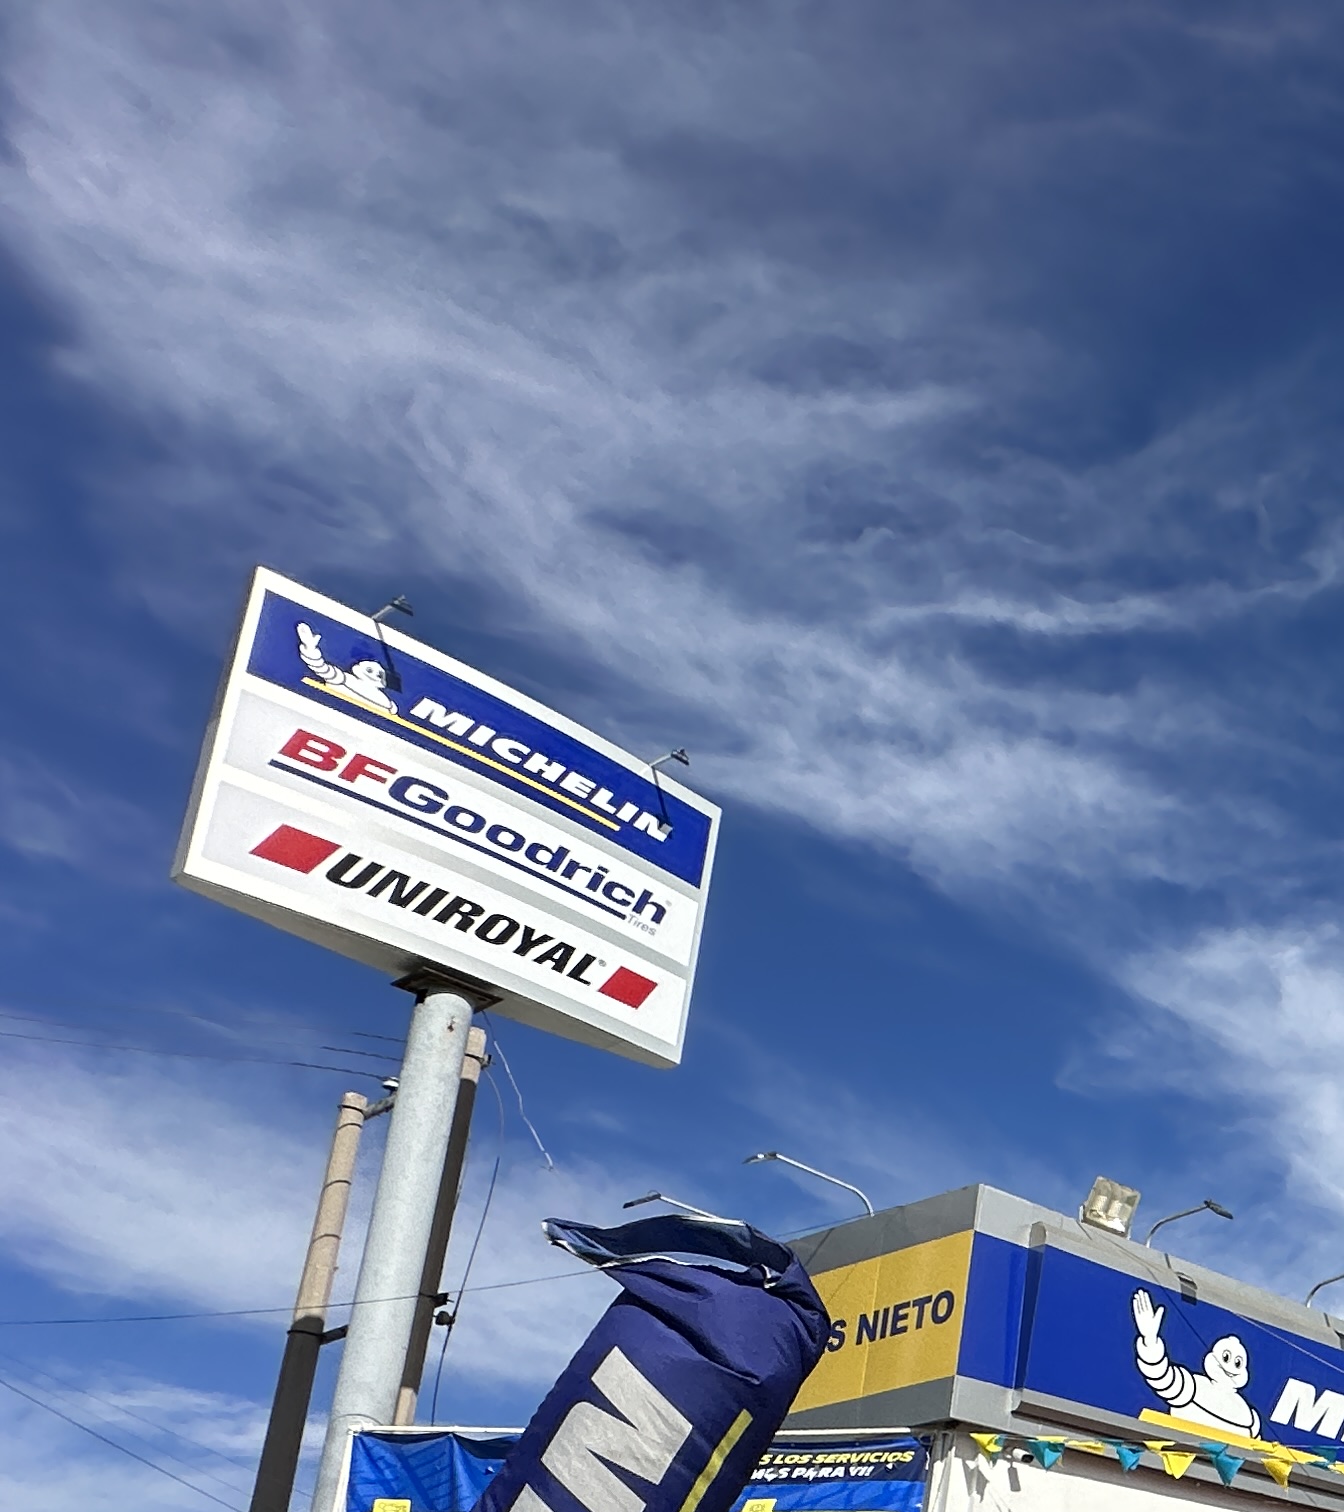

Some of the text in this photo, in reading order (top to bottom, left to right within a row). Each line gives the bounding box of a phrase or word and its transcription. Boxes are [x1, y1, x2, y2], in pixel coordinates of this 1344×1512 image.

[410, 697, 672, 841] MICHELIN
[278, 728, 667, 925] BFGoodrich
[326, 854, 596, 985] UNIROYAL
[628, 914, 657, 936] Tires
[855, 1290, 955, 1346] NIETO
[773, 1454, 812, 1464] LOS
[812, 1451, 915, 1464] SERVICIOS
